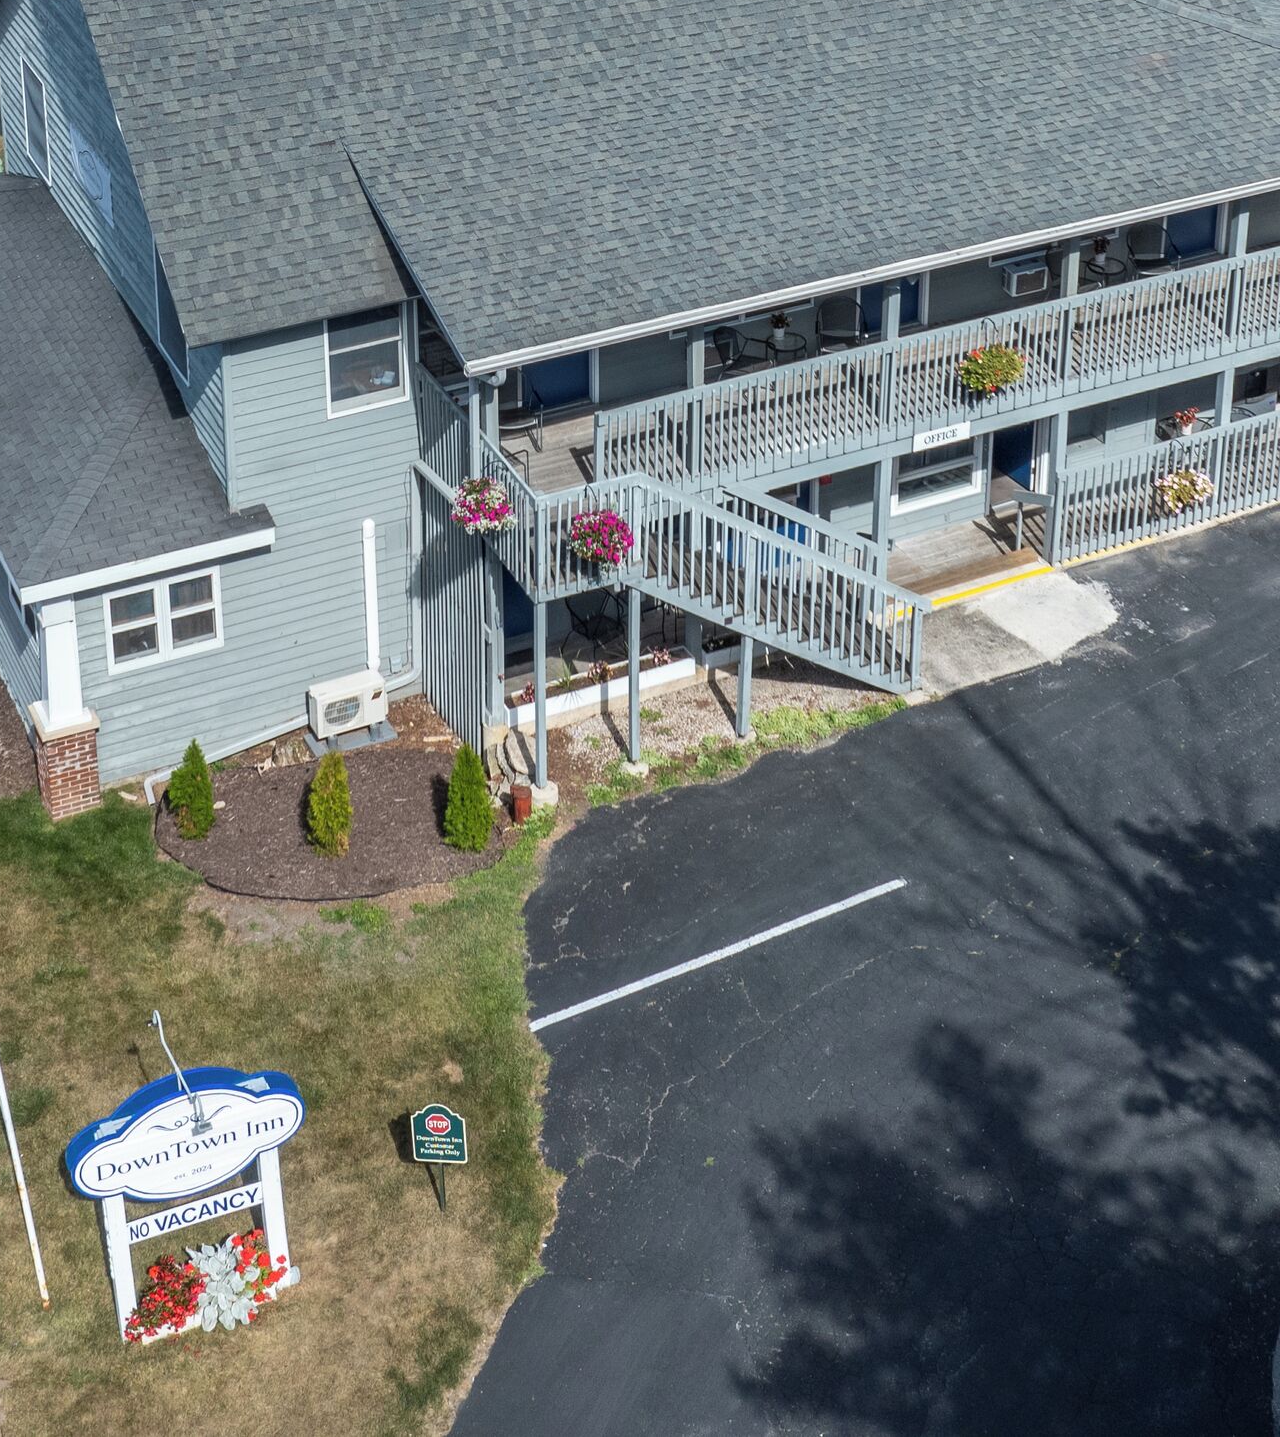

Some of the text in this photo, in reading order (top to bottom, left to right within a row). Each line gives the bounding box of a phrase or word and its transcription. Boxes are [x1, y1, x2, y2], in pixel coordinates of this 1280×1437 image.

[923, 428, 958, 445] OFFICE
[428, 1120, 448, 1129] STOP
[96, 1116, 285, 1182] DownTown Inn
[420, 1148, 461, 1157] Parking Only
[191, 1164, 213, 1176] 2024
[129, 1187, 259, 1241] NO VACANCY
